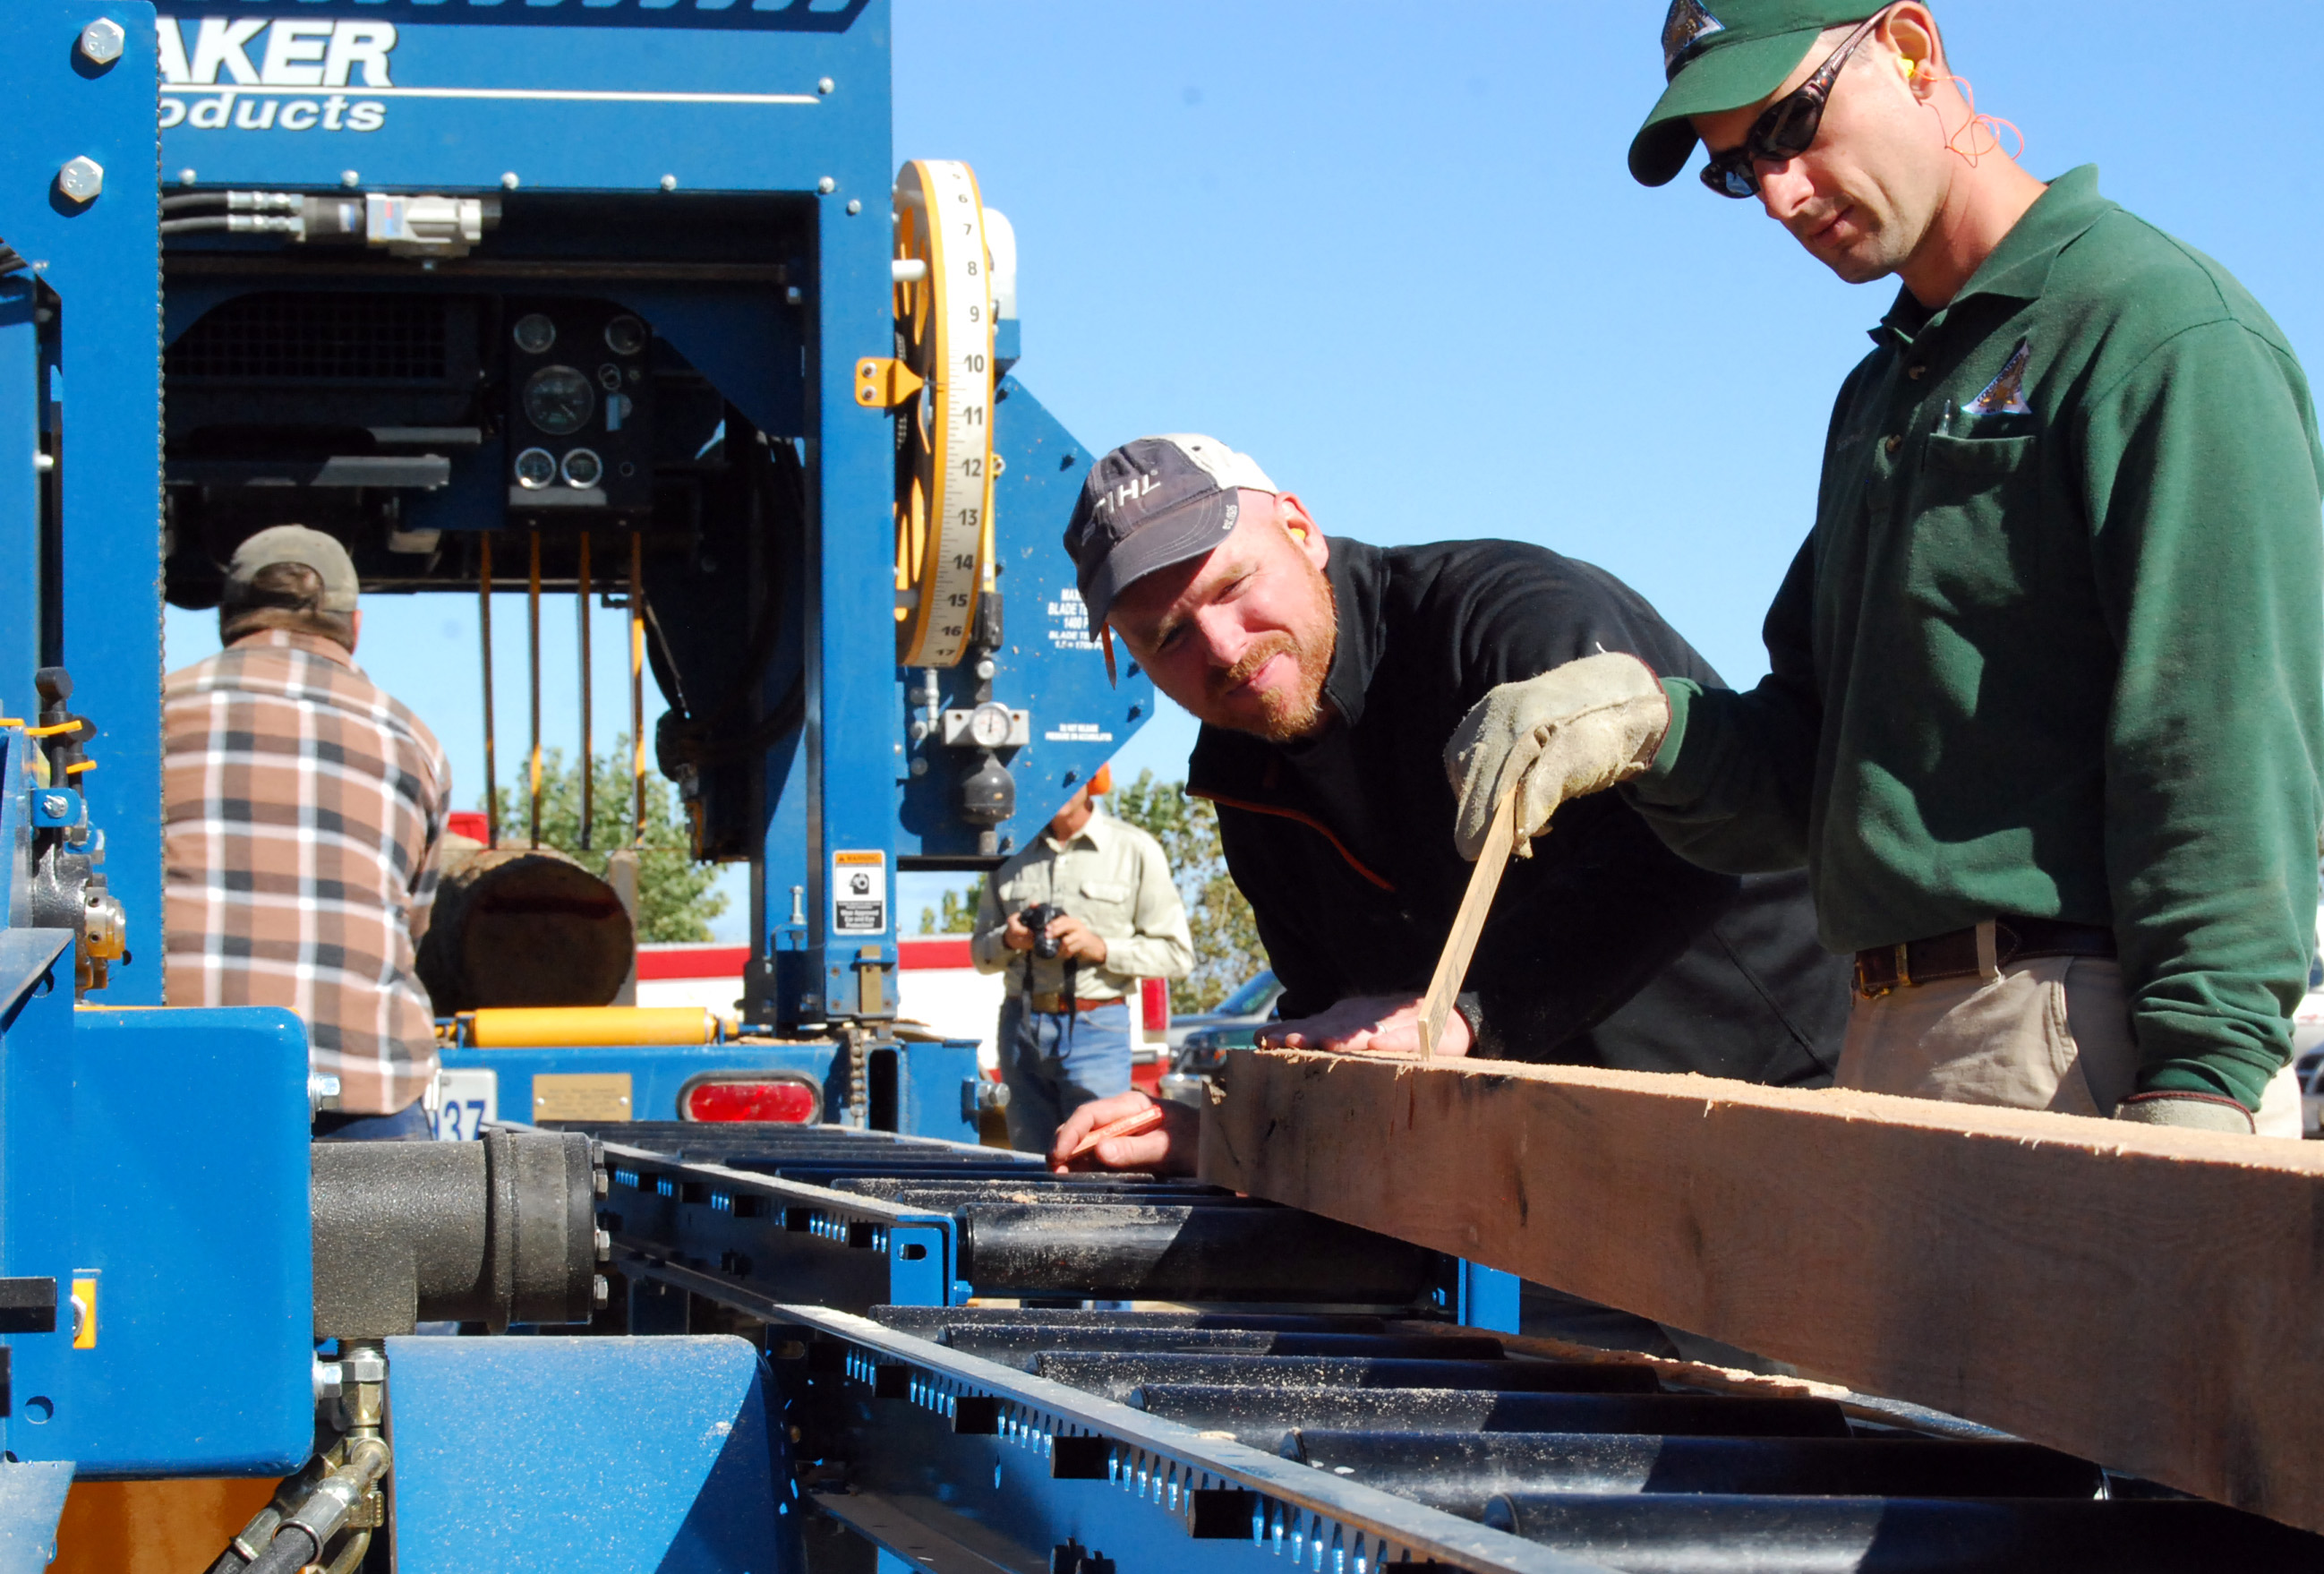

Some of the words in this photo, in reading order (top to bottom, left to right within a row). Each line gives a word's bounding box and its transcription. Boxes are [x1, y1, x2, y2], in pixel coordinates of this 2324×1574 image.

[157, 16, 397, 87] AKER
[159, 92, 388, 132] oducts
[958, 193, 968, 203] 6
[963, 223, 972, 235] 7
[968, 261, 978, 276] 8
[970, 305, 979, 322] 9
[964, 354, 985, 373] 10
[963, 406, 983, 425] 11
[962, 458, 981, 476] 12
[958, 509, 978, 526] 13
[953, 554, 974, 570] 14
[948, 594, 968, 607] 15
[1047, 602, 1078, 616] BLADE
[1064, 616, 1082, 629] 1400
[942, 626, 962, 637] 16
[1048, 630, 1079, 640] BLADE
[433, 1099, 486, 1141] 37
